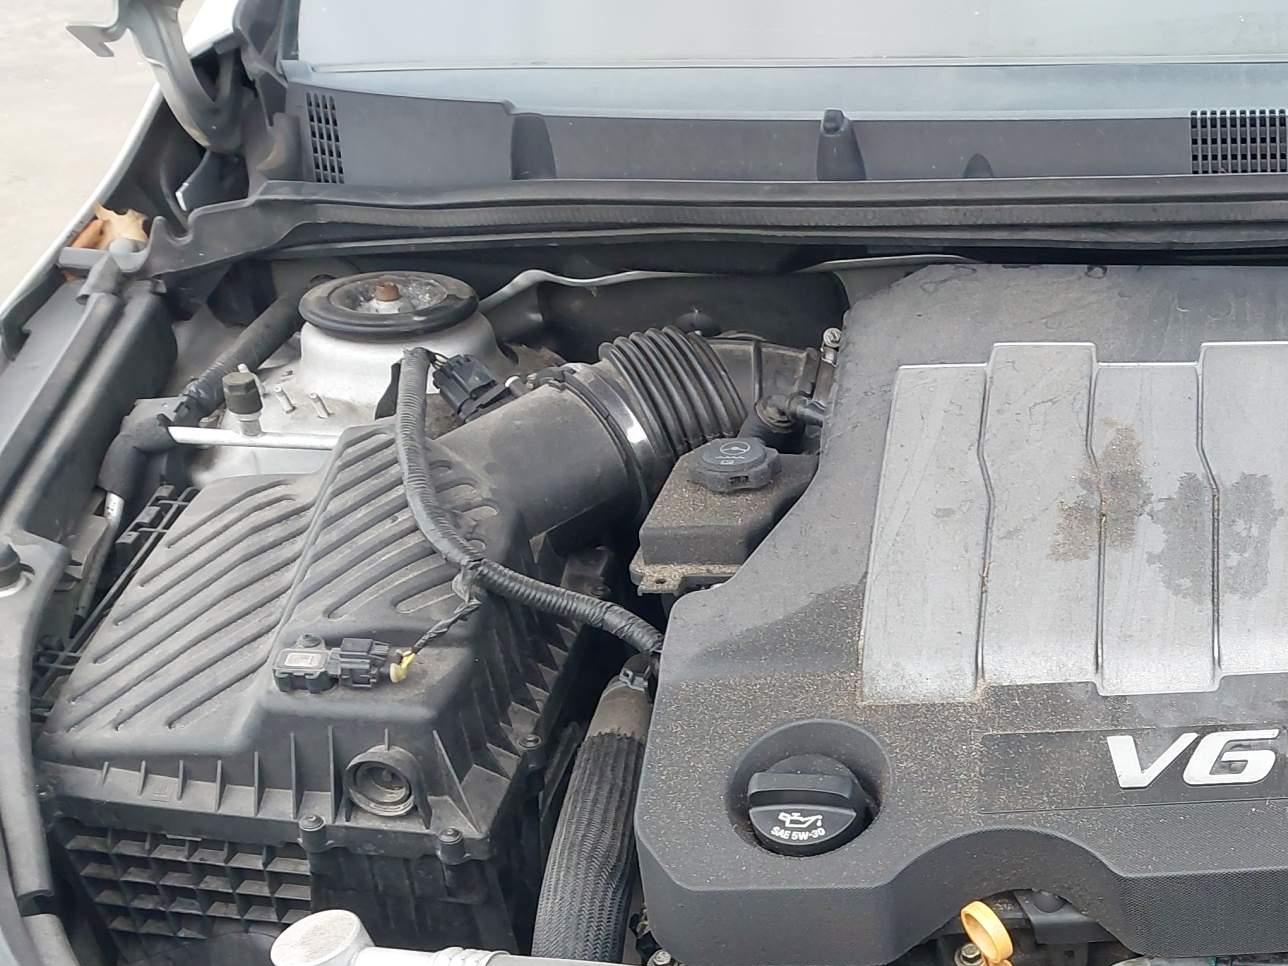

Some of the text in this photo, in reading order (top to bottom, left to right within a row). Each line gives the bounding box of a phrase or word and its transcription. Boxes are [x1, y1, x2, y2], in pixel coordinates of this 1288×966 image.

[1106, 729, 1279, 788] V6
[771, 826, 826, 841] SAE 5W-30
